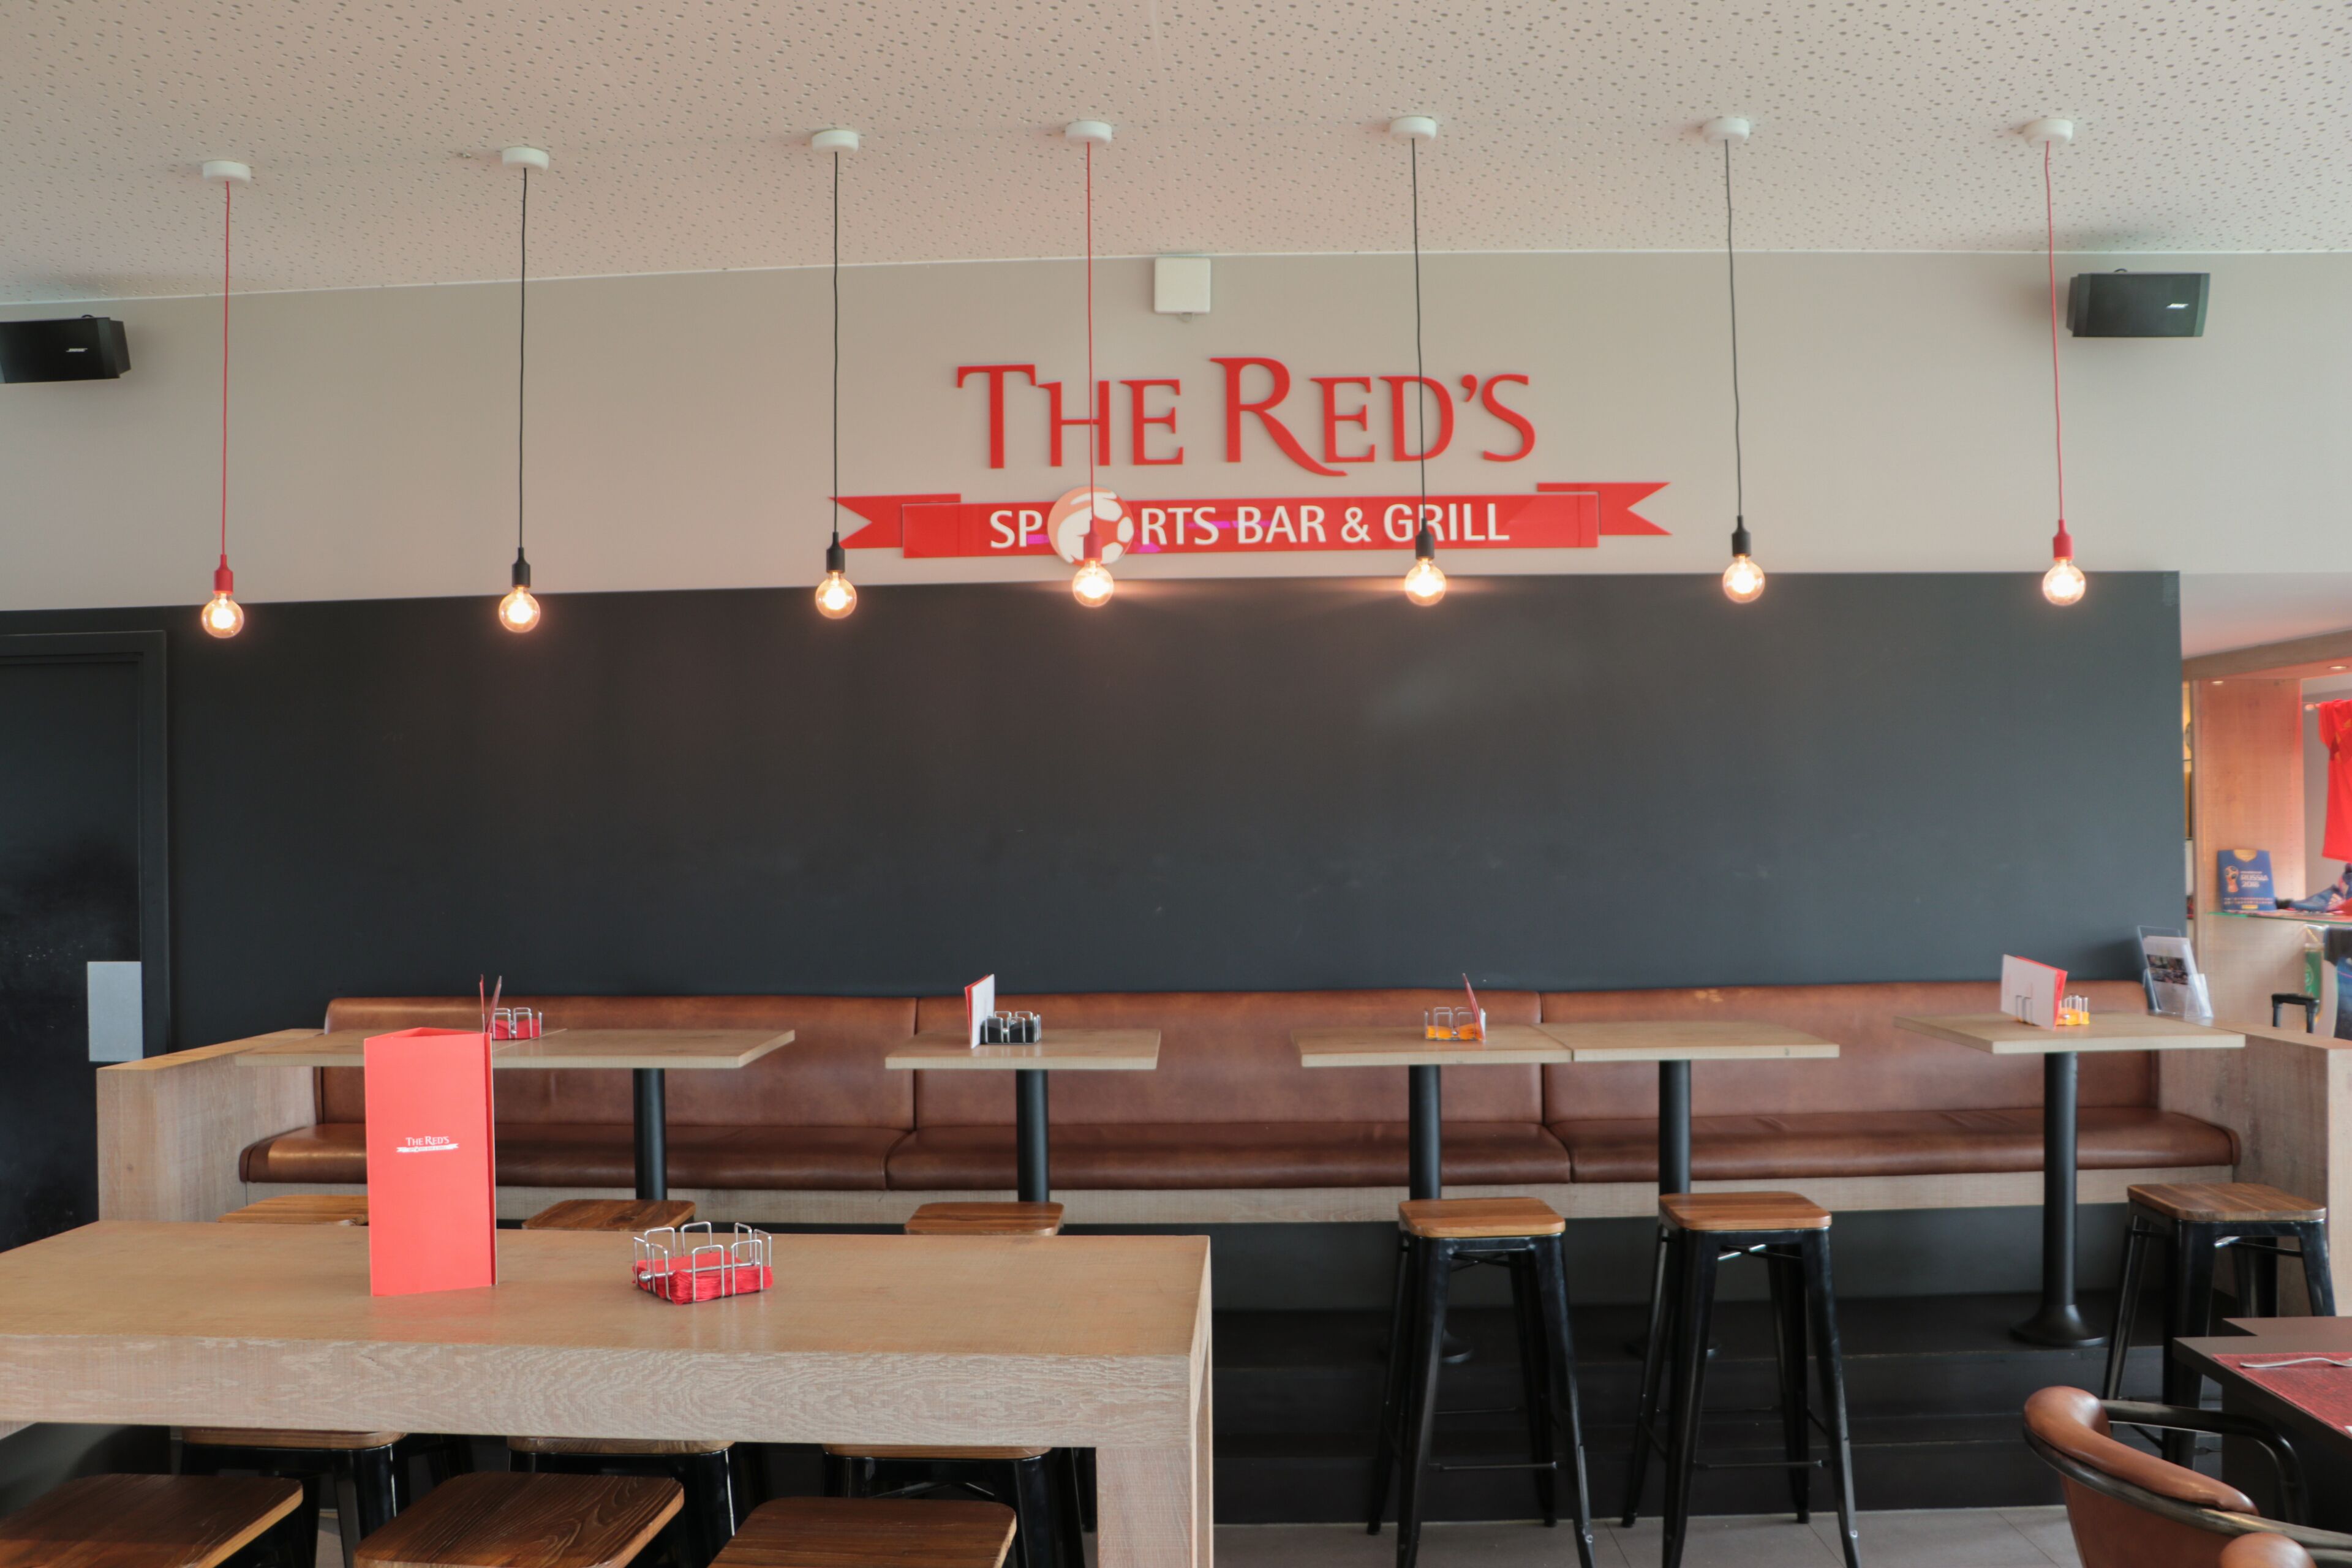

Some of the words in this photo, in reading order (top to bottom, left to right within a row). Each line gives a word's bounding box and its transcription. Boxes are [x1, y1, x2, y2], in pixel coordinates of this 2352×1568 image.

[956, 364, 1184, 469] THE
[1208, 356, 1536, 477] RED'S
[1237, 505, 1327, 544] BAR
[1340, 506, 1372, 543] &
[1383, 503, 1510, 542] GRILL
[405, 1137, 424, 1146] THE
